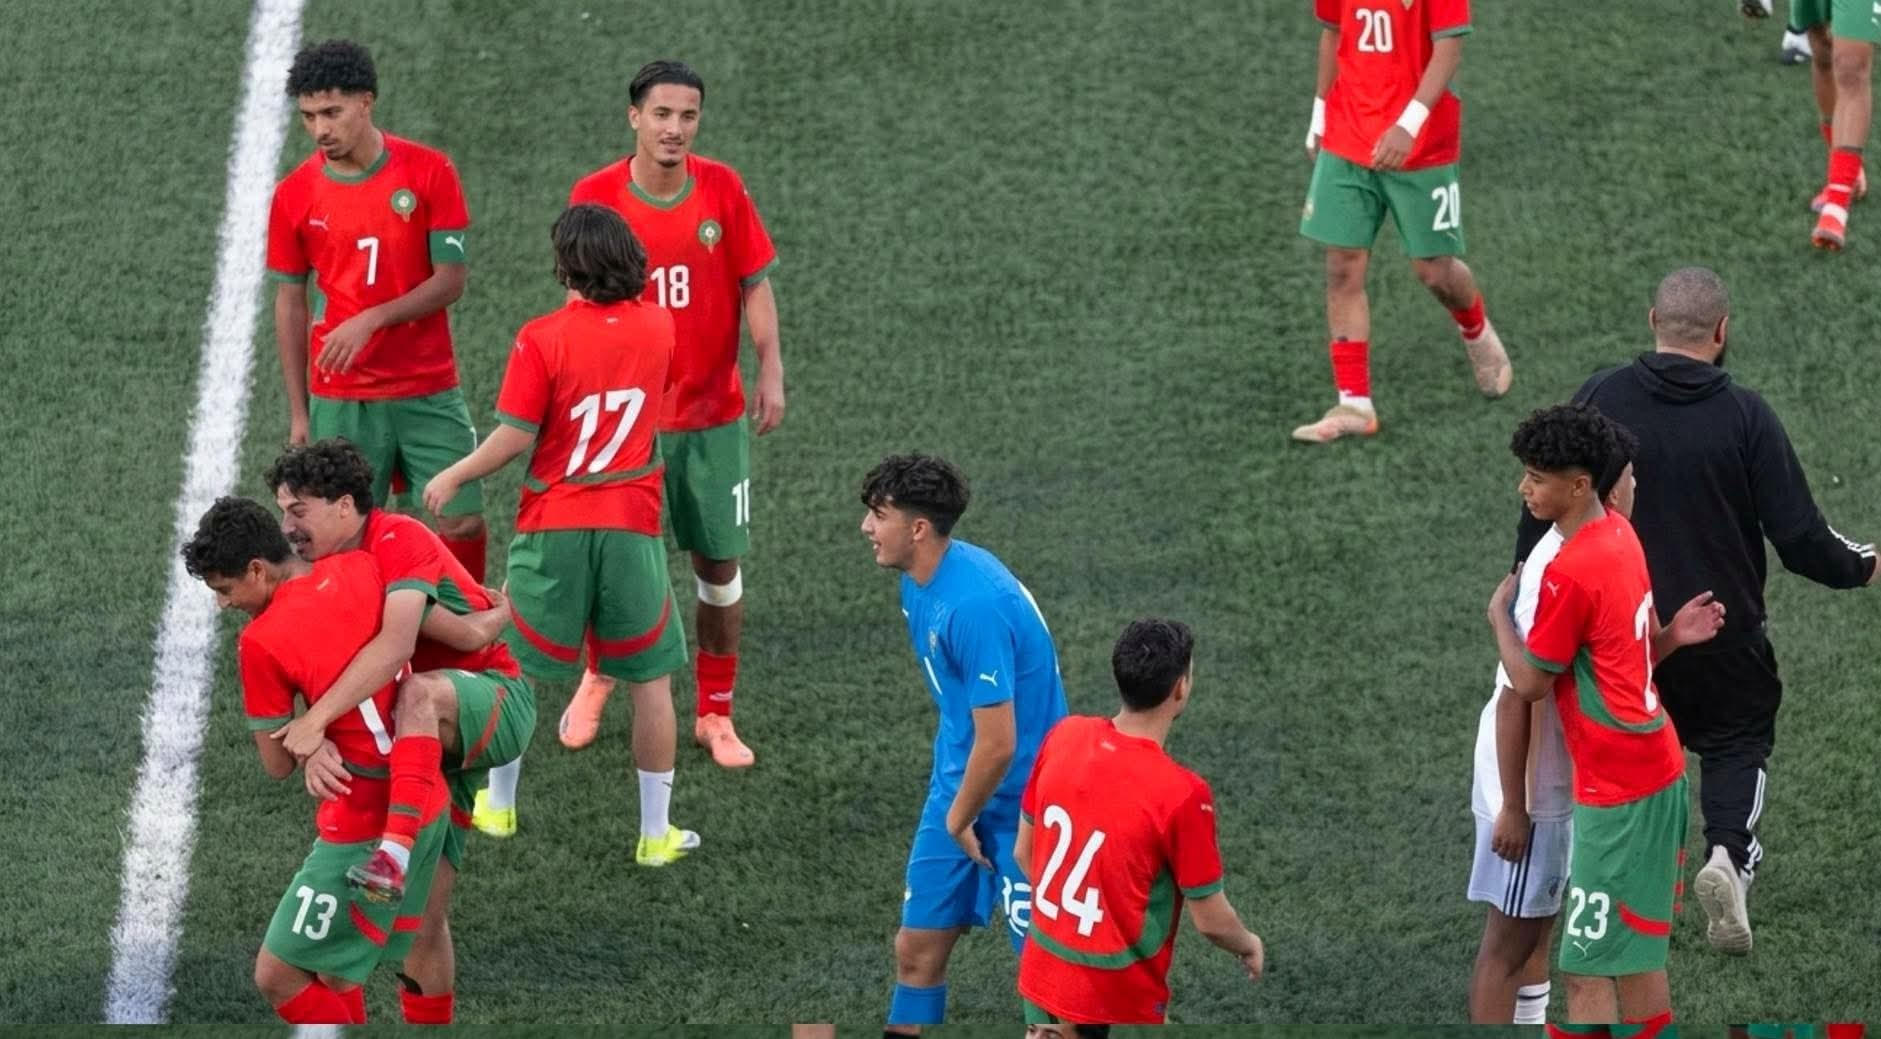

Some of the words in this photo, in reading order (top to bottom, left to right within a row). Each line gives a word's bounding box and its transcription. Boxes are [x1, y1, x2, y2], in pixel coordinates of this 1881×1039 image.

[1355, 8, 1392, 53] 20
[1431, 181, 1460, 231] 20
[356, 237, 379, 286] 7
[650, 264, 689, 309] 18
[565, 387, 647, 477] 17
[1035, 804, 1106, 938] 24
[292, 885, 338, 941] 13
[1566, 886, 1610, 940] 23
